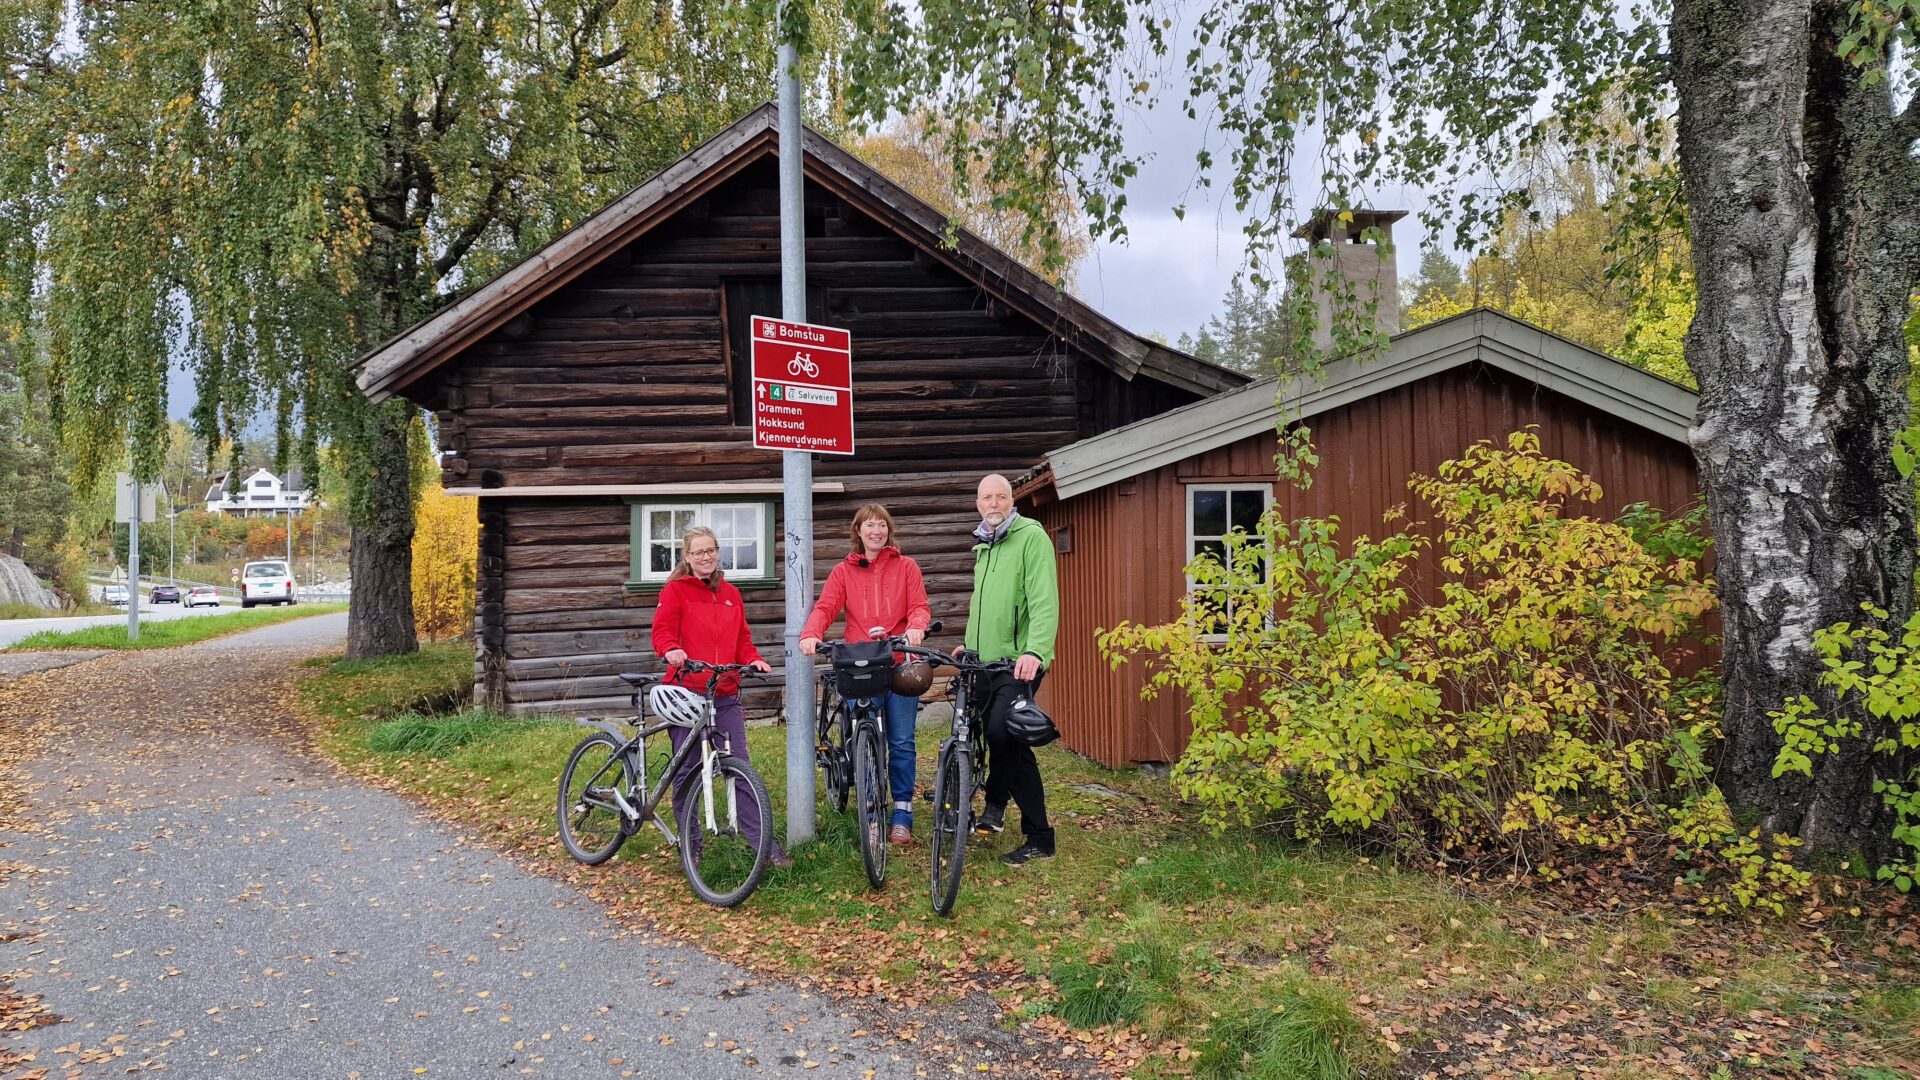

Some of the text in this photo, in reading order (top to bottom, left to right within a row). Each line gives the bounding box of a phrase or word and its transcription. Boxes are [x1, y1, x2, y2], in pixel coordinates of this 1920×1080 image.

[779, 325, 825, 342] Bomstua
[773, 388, 835, 403] 4 Sølvveien
[758, 402, 803, 415] Drammen
[758, 417, 805, 430] Hokksund
[759, 431, 837, 447] Kjennerudvannet
